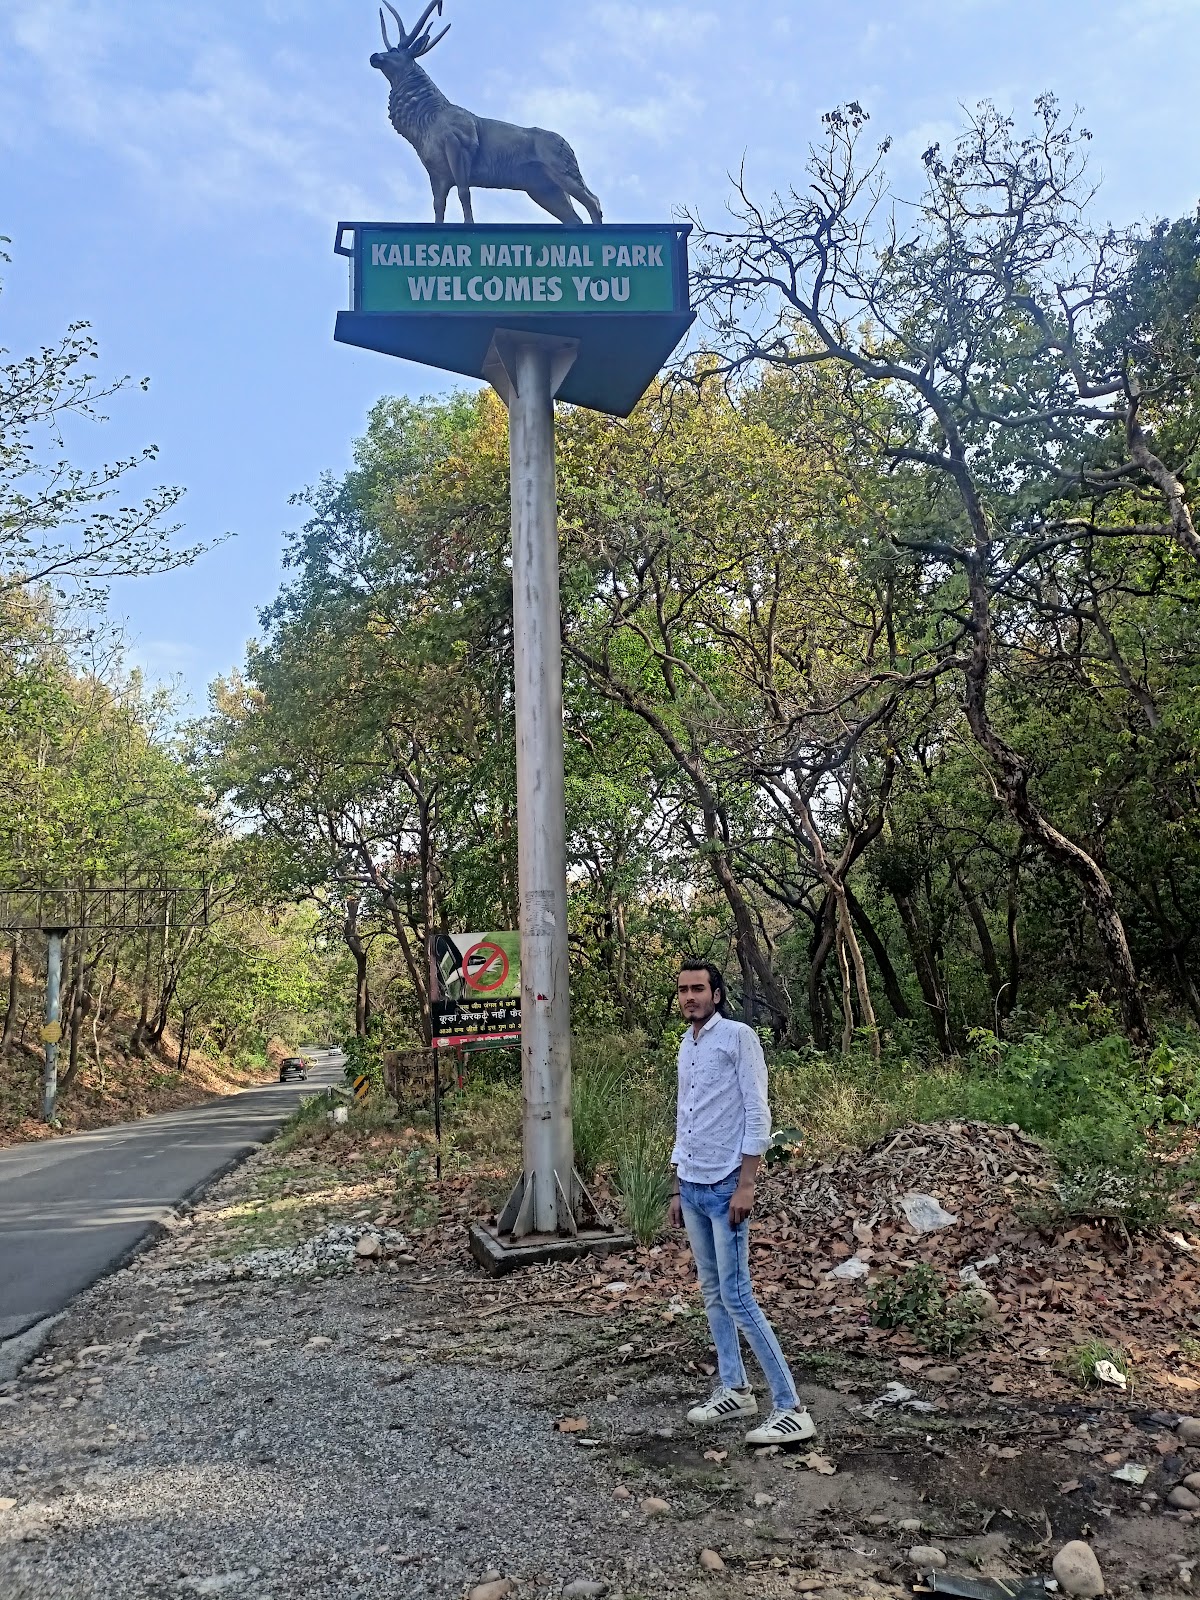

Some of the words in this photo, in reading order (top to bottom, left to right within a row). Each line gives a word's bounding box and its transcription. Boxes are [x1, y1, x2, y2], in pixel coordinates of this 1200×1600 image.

[371, 244, 472, 266] KALESAR
[602, 245, 664, 267] PARK
[407, 275, 563, 301] WELCOMES
[571, 276, 630, 301] YOU
[491, 1009, 506, 1019] नहीं
